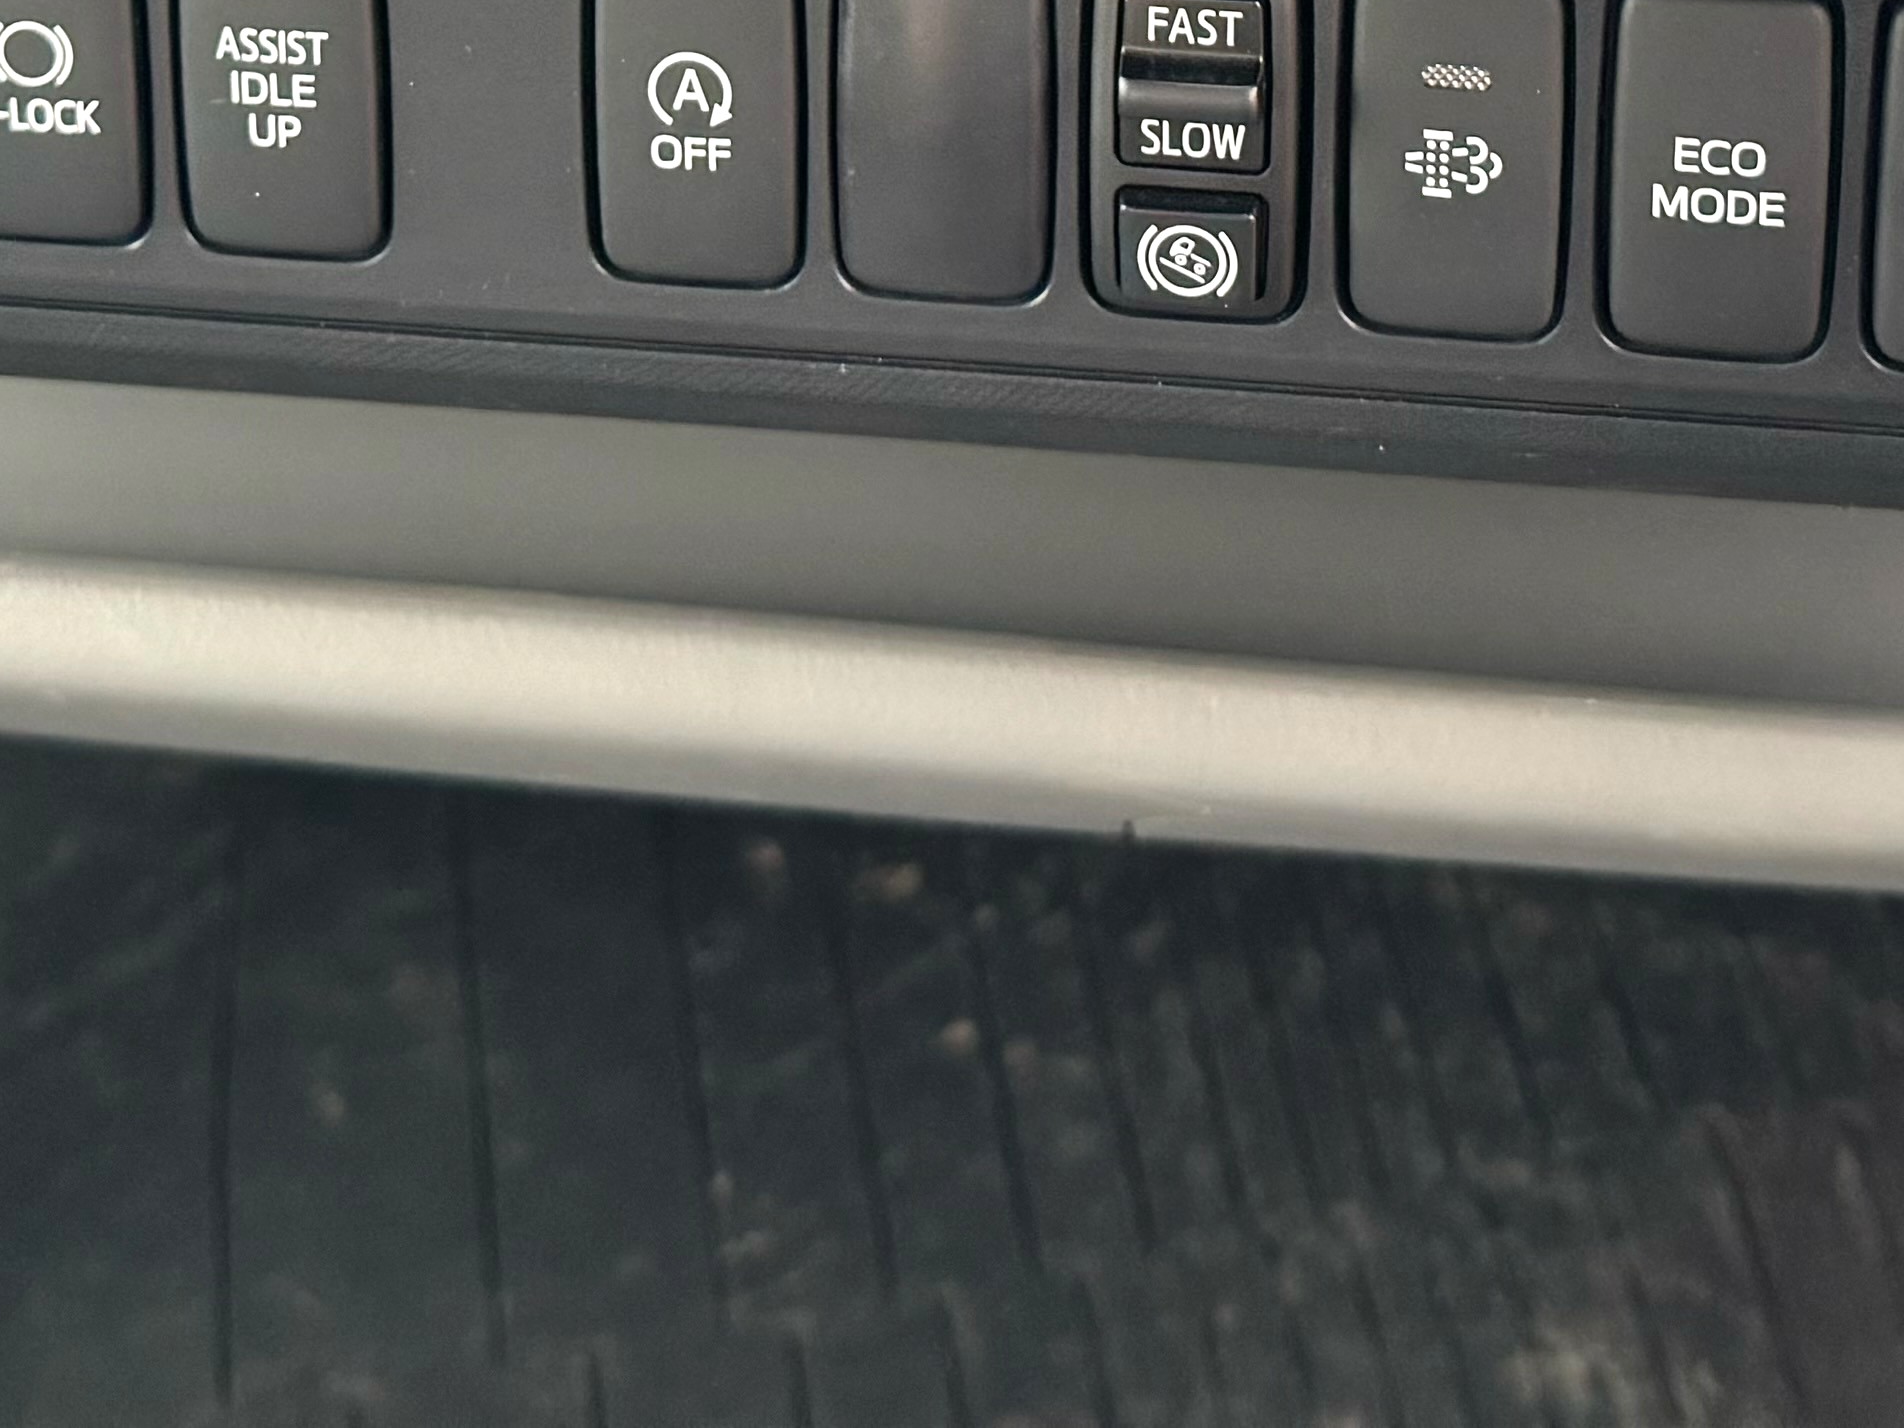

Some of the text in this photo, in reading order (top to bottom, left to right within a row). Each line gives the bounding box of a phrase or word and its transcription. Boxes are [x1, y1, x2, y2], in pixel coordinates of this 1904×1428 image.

[216, 27, 329, 66] ASSIST
[1146, 6, 1244, 48] FAST
[230, 71, 317, 107] IDLE
[249, 114, 302, 148] UP
[1140, 118, 1246, 161] SLOW
[650, 135, 732, 171] OFF
[1672, 136, 1767, 176] ECO
[1649, 184, 1786, 227] MODE
